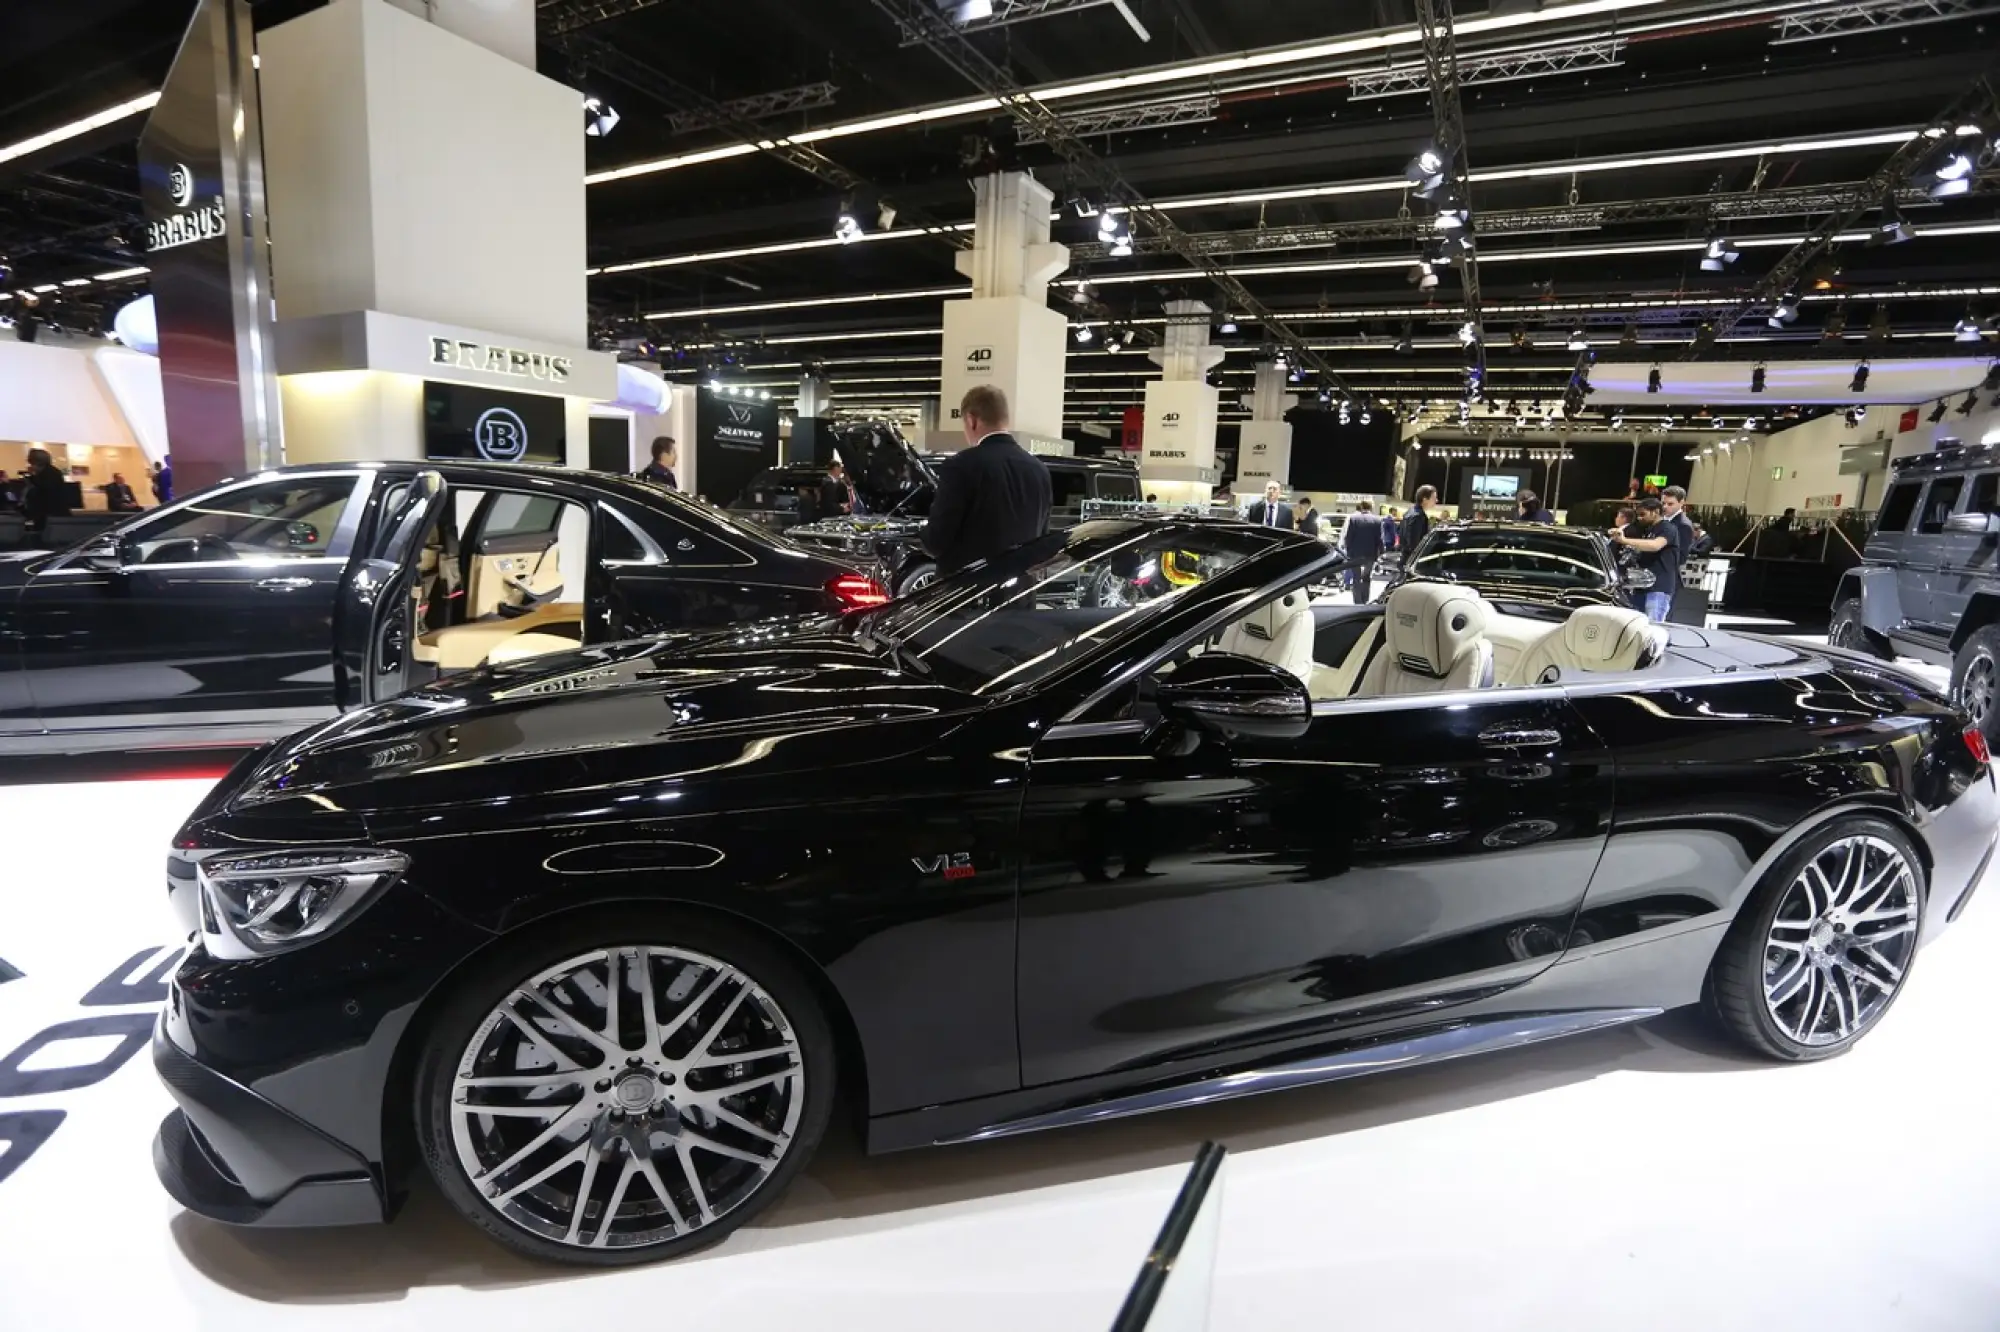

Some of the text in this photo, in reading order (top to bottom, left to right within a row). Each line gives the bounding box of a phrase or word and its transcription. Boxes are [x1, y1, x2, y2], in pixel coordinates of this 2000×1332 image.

[145, 205, 226, 253] BRABUS
[967, 349, 992, 363] 40
[1162, 412, 1180, 421] 40
[486, 420, 519, 455] B
[1149, 450, 1186, 458] BRABUS
[911, 852, 972, 874] V12
